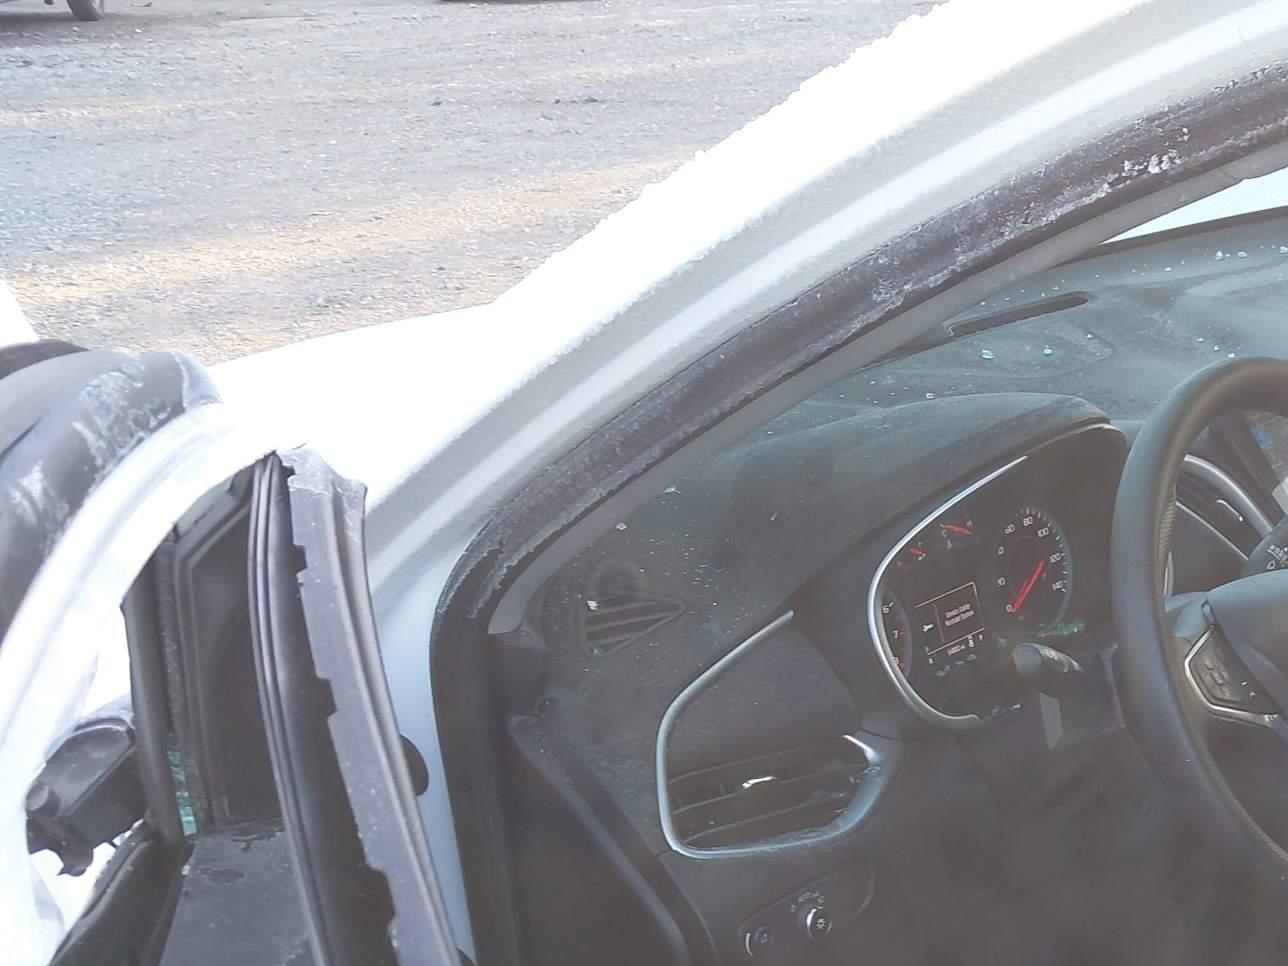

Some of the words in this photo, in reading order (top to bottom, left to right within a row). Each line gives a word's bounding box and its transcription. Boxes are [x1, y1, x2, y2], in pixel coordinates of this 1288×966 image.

[1023, 516, 1033, 526] 80
[1005, 524, 1015, 534] 60
[1037, 527, 1049, 537] 100
[1050, 552, 1061, 563] 120
[1052, 580, 1064, 591] 140
[883, 605, 890, 613] 6
[1006, 604, 1013, 612] 0
